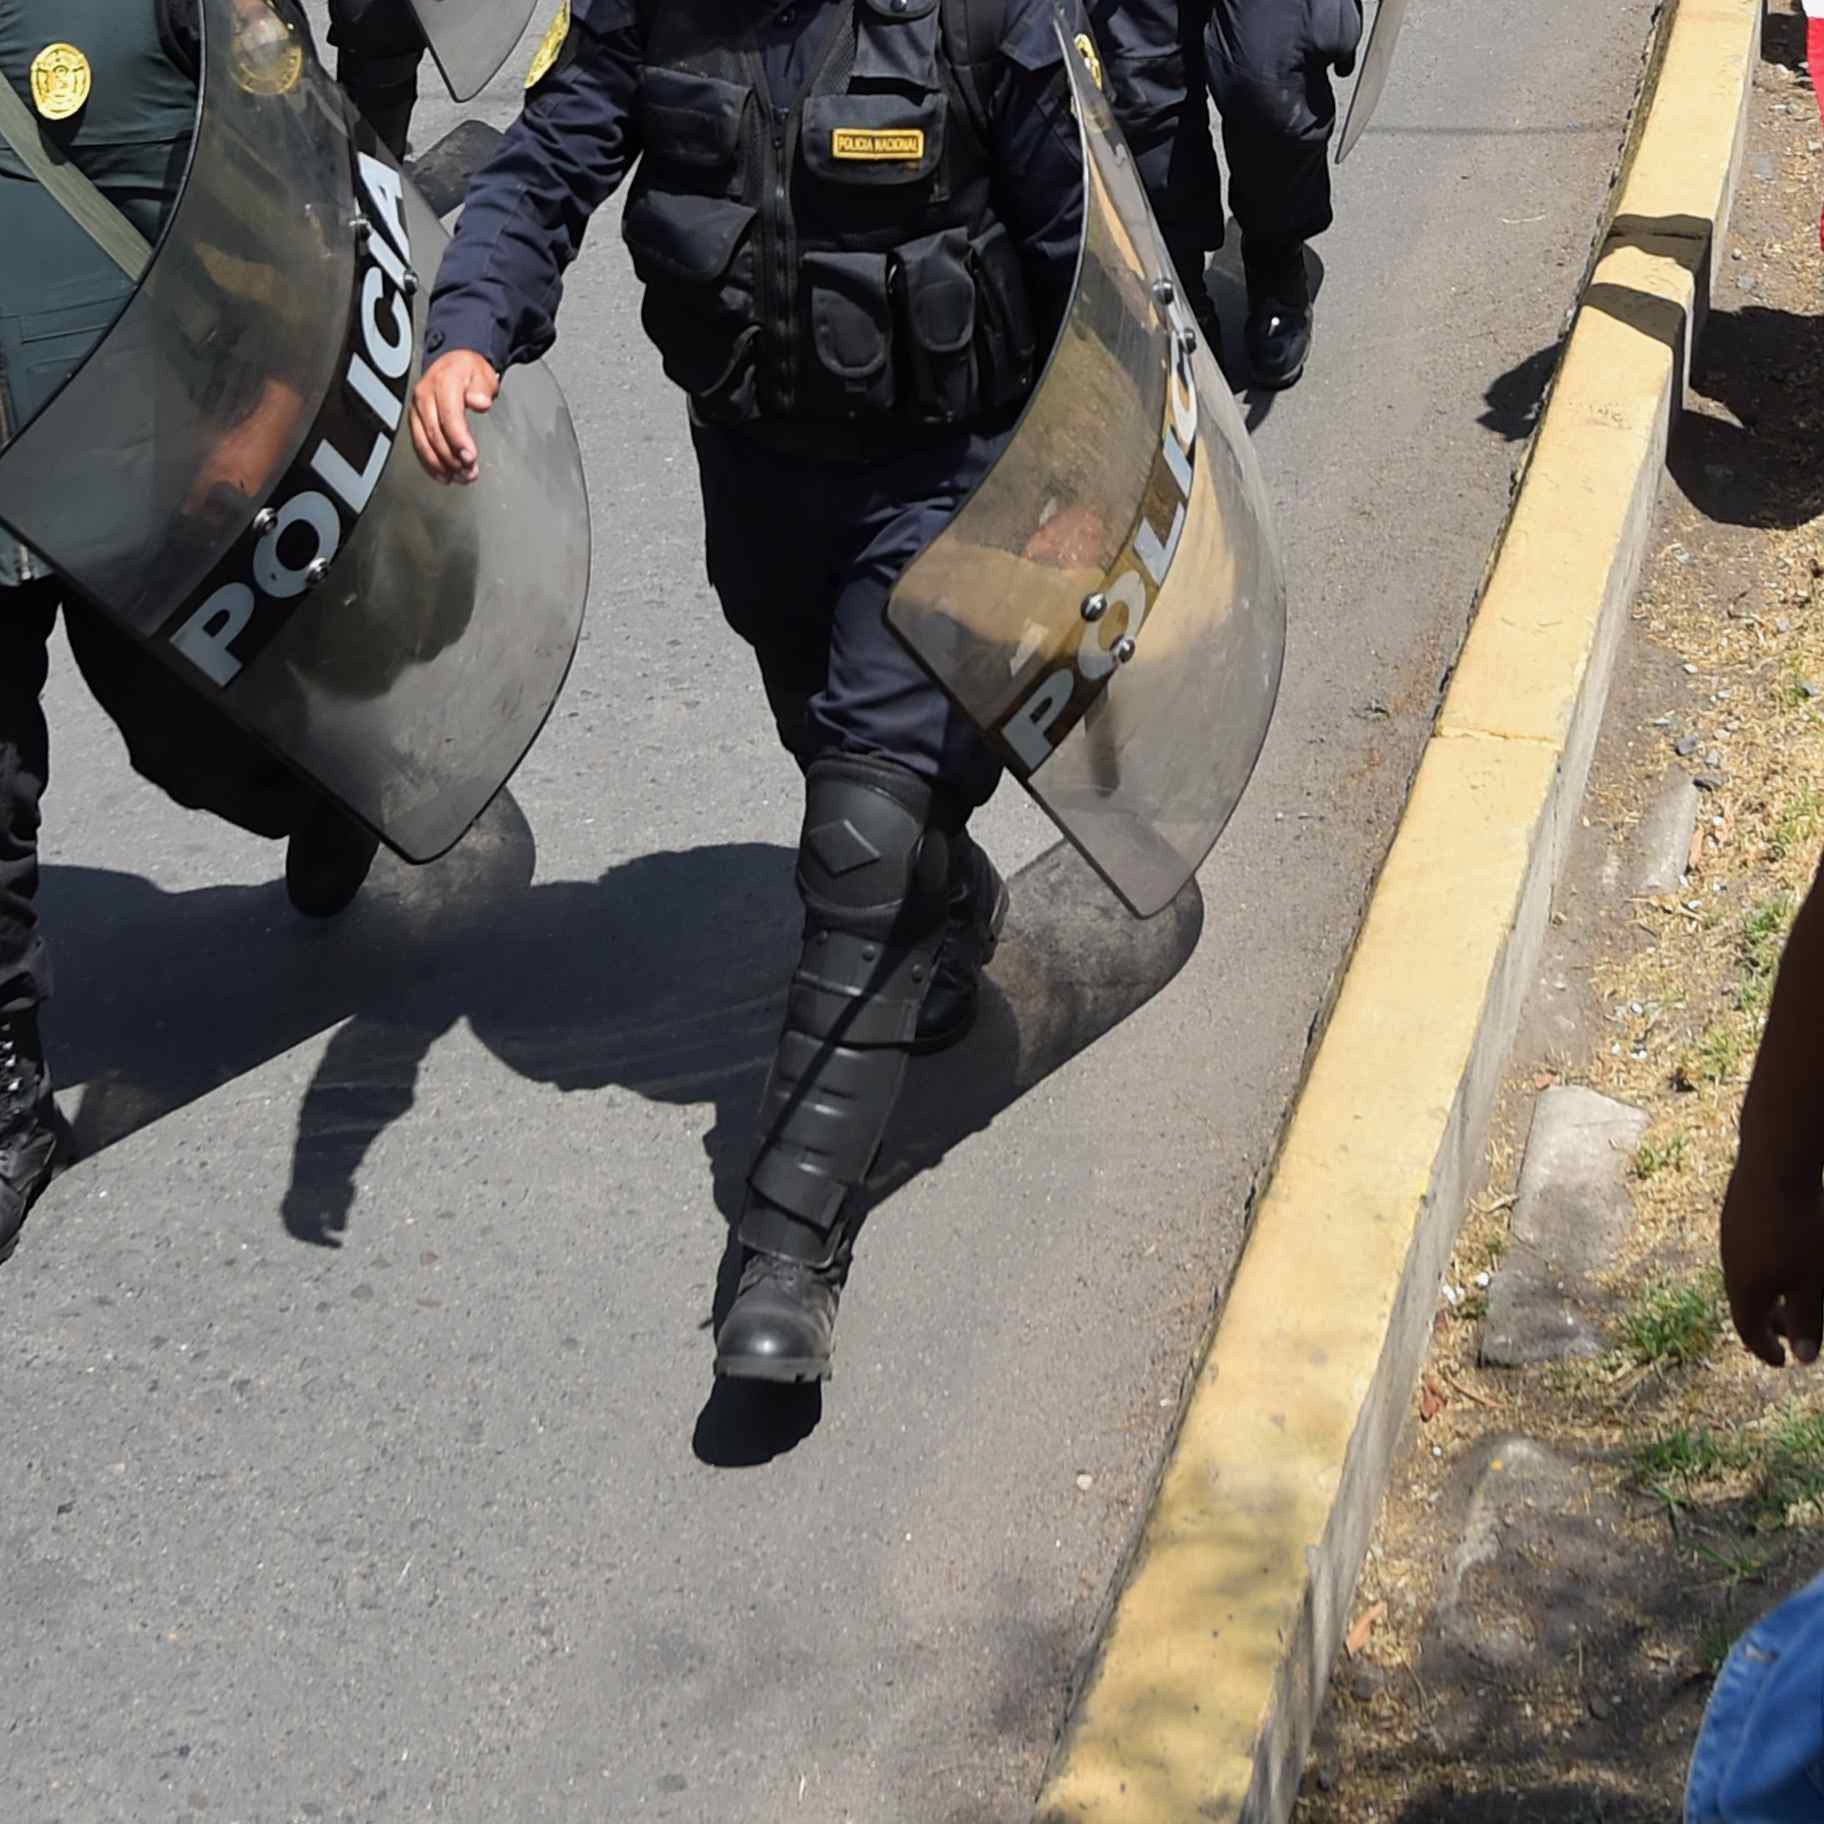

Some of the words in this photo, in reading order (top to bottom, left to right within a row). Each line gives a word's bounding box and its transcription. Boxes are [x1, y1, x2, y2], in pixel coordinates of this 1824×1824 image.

[838, 136, 874, 151] POLICIA
[874, 137, 919, 153] NACIONAL
[168, 151, 417, 691] POLICIA
